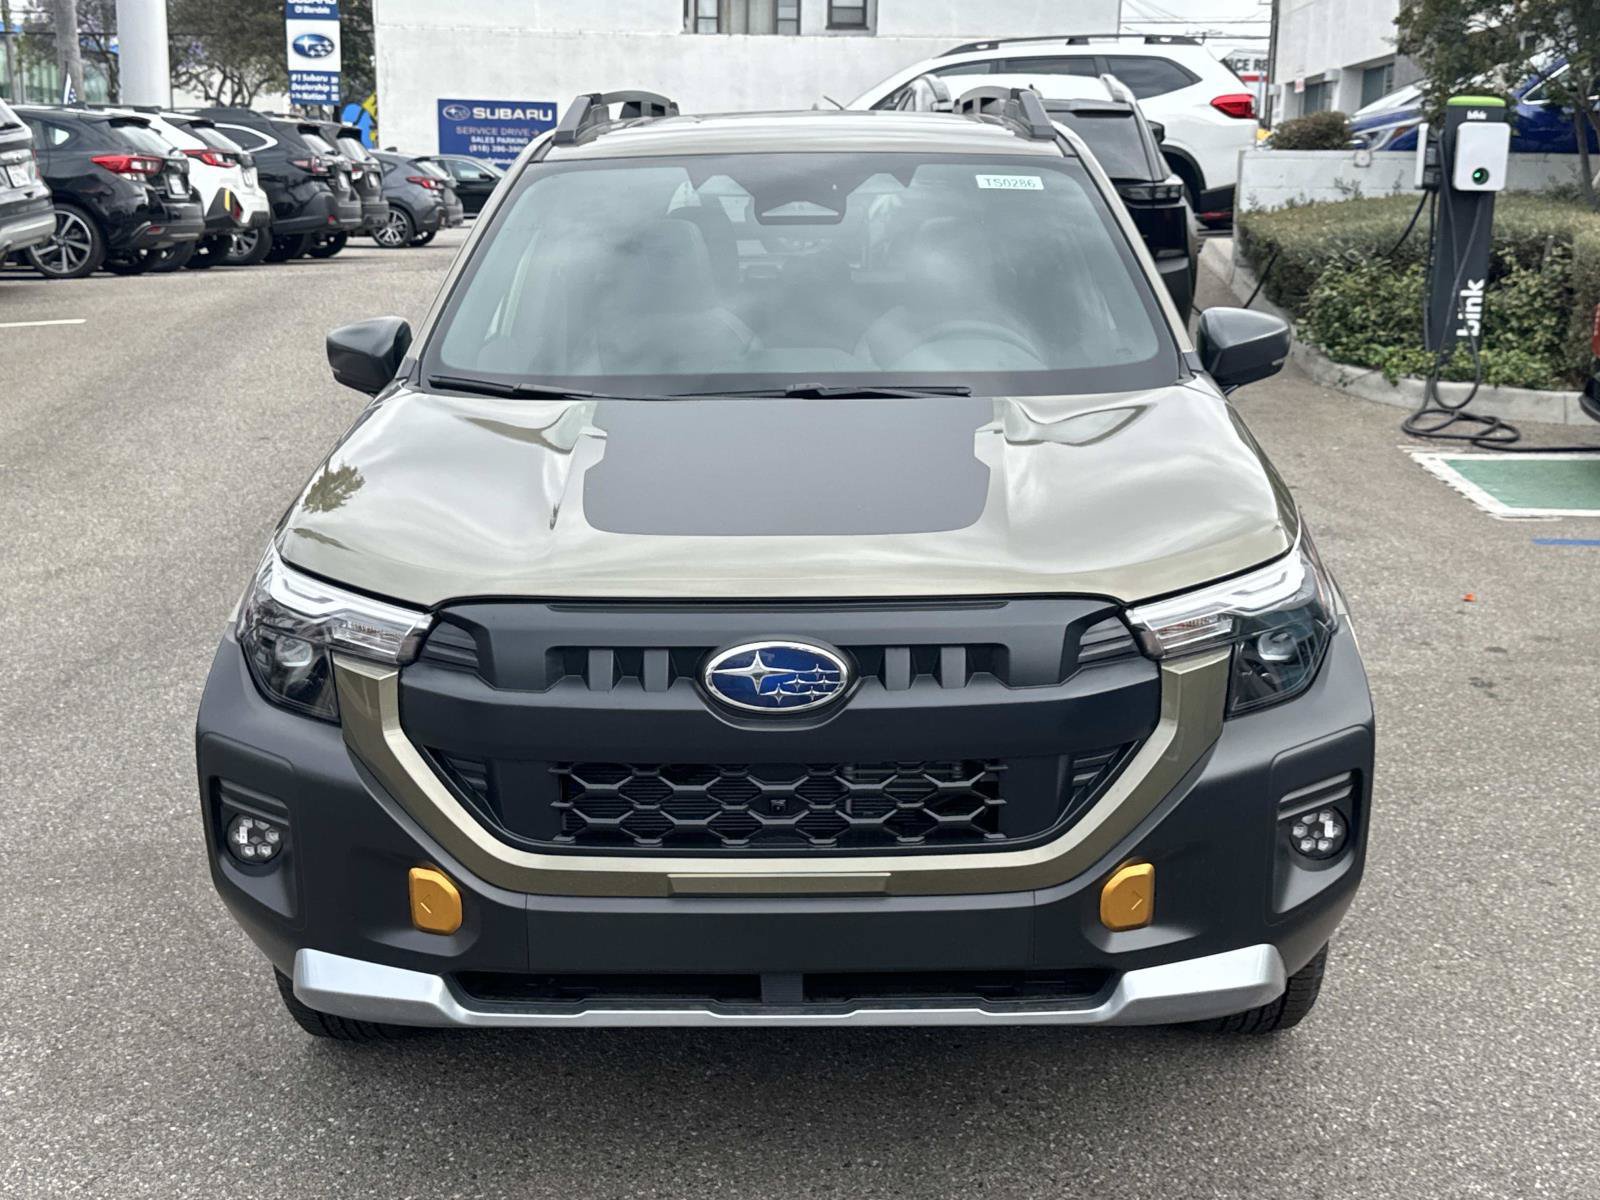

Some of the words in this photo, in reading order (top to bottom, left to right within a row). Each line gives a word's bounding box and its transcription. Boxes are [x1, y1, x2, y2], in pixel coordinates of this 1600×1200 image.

[472, 106, 553, 121] SUBARU
[456, 126, 498, 136] SERVICE
[500, 127, 531, 137] DRIVE
[471, 136, 495, 144] SALES
[496, 136, 529, 145] PARKING
[983, 177, 1036, 188] TS0286
